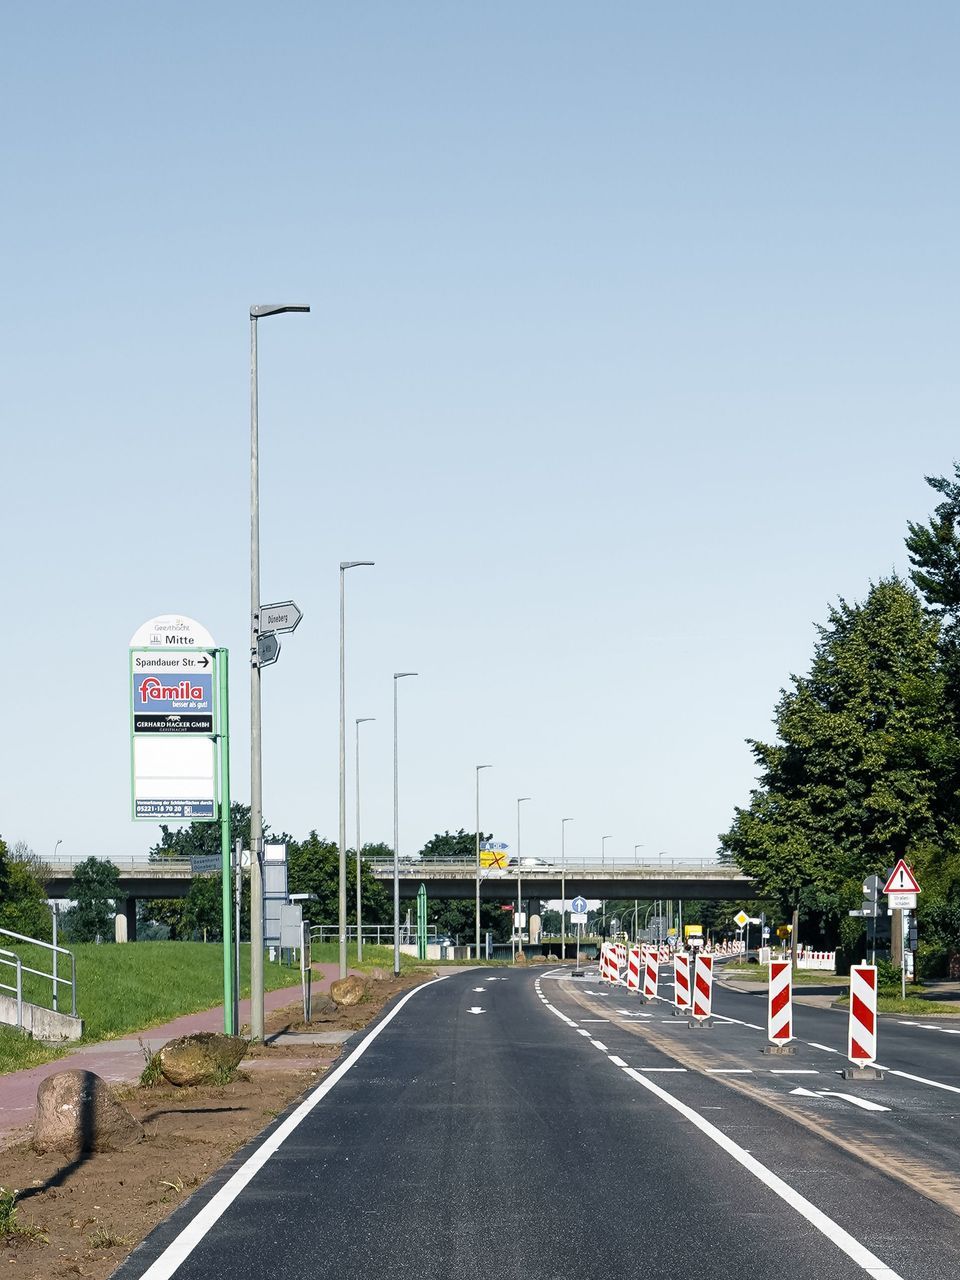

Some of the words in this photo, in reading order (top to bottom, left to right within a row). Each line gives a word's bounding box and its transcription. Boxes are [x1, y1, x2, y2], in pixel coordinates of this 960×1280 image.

[165, 635, 195, 645] Mitte
[135, 658, 179, 667] Spandauer
[182, 657, 196, 666] Str.
[139, 677, 203, 703] famila
